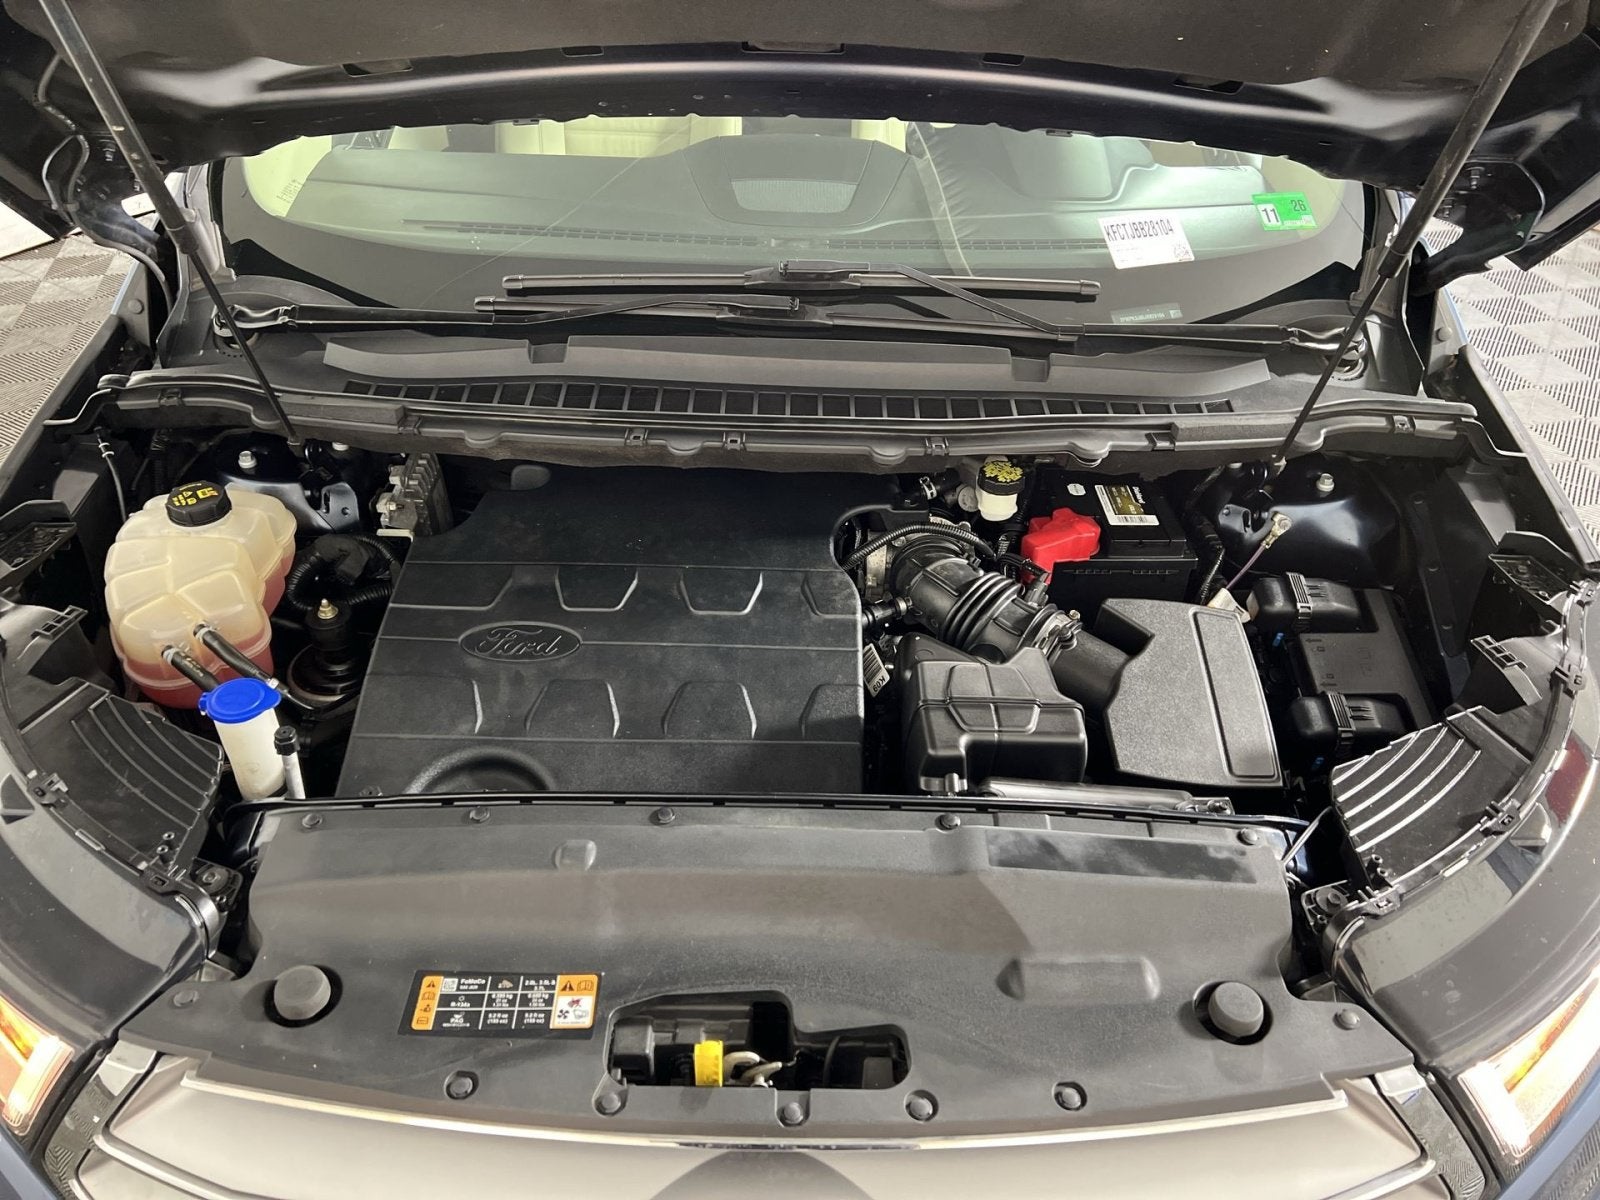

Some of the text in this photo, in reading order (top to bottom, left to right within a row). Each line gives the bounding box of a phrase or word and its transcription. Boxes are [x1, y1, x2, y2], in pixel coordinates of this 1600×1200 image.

[1290, 199, 1307, 212] 26
[1261, 208, 1280, 223] 11
[475, 627, 562, 656] Ford
